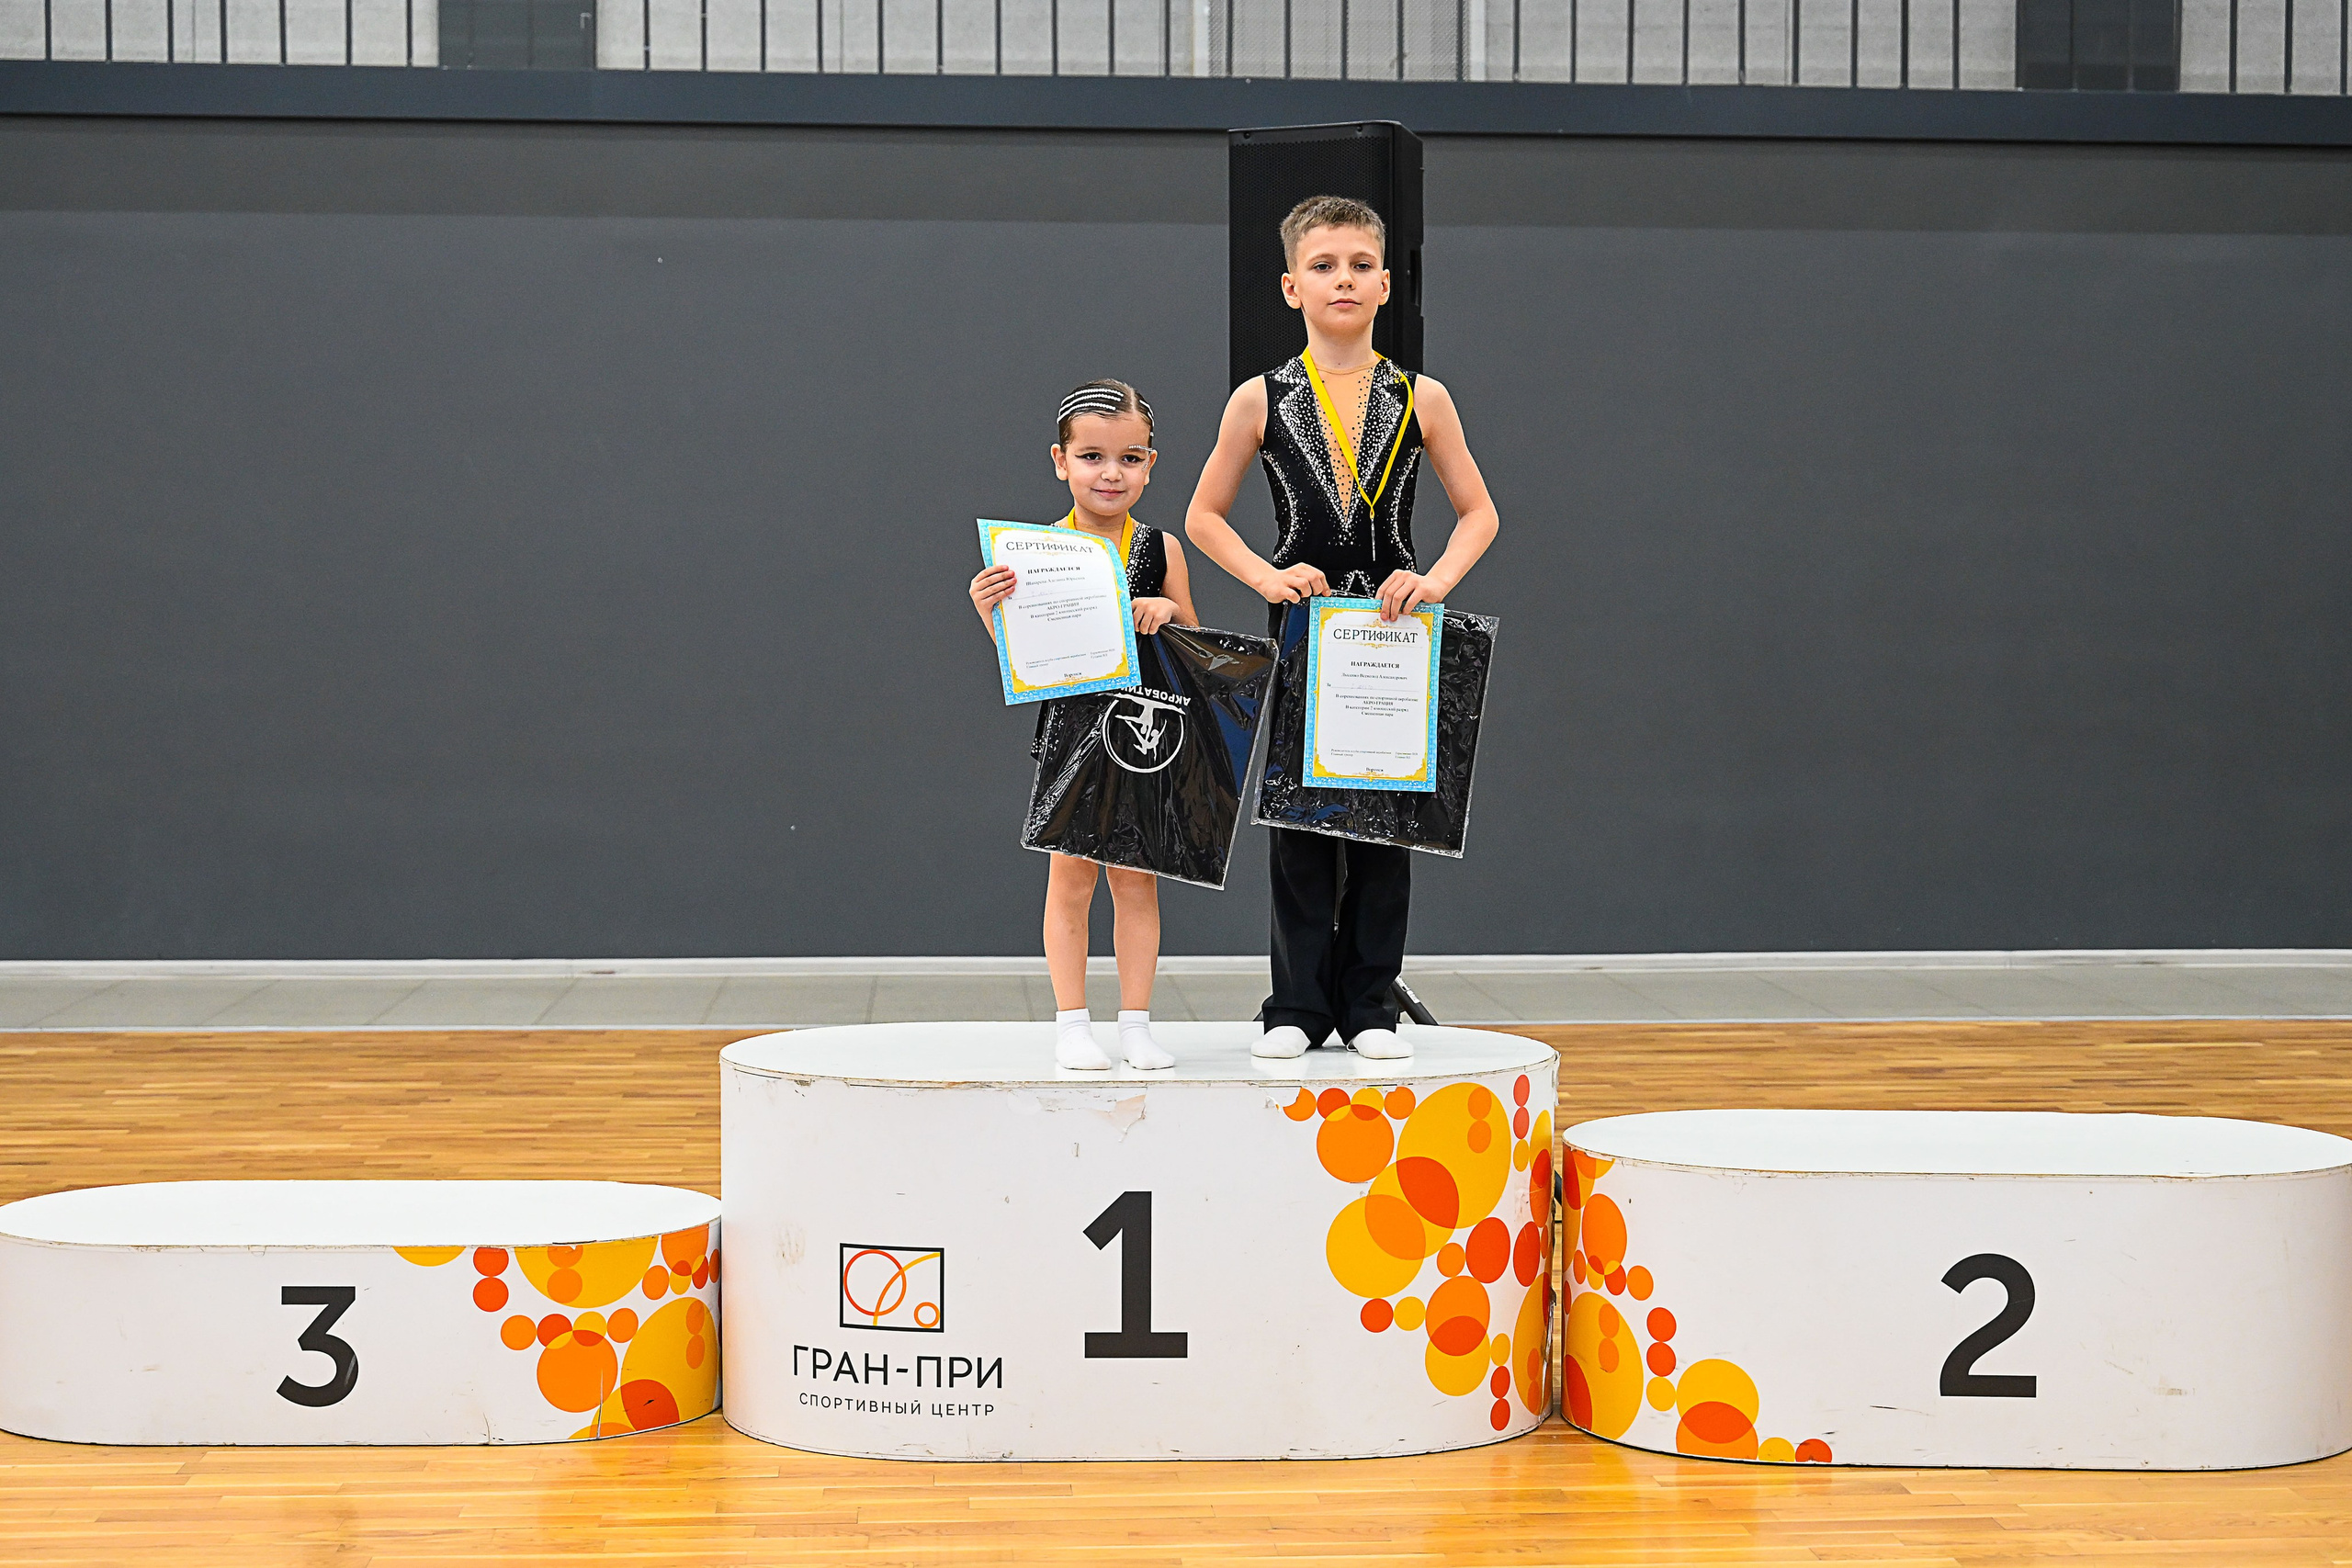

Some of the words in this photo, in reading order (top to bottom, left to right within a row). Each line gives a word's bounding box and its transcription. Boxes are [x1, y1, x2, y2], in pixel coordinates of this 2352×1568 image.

[1006, 541, 1093, 553] СЕРТИФИКАТ
[1333, 628, 1419, 643] СЕРТИФИКАТ
[1351, 660, 1400, 669] НАГРАЖДАЕТСЯ
[1083, 1191, 1188, 1358] 1
[1939, 1254, 2037, 1397] 2
[277, 1286, 359, 1407] 3
[793, 1344, 1002, 1389] ГРАН-ПРИ
[799, 1393, 922, 1416] СПОРТИВНЫЙ
[932, 1404, 995, 1418] ЦЕНТР
